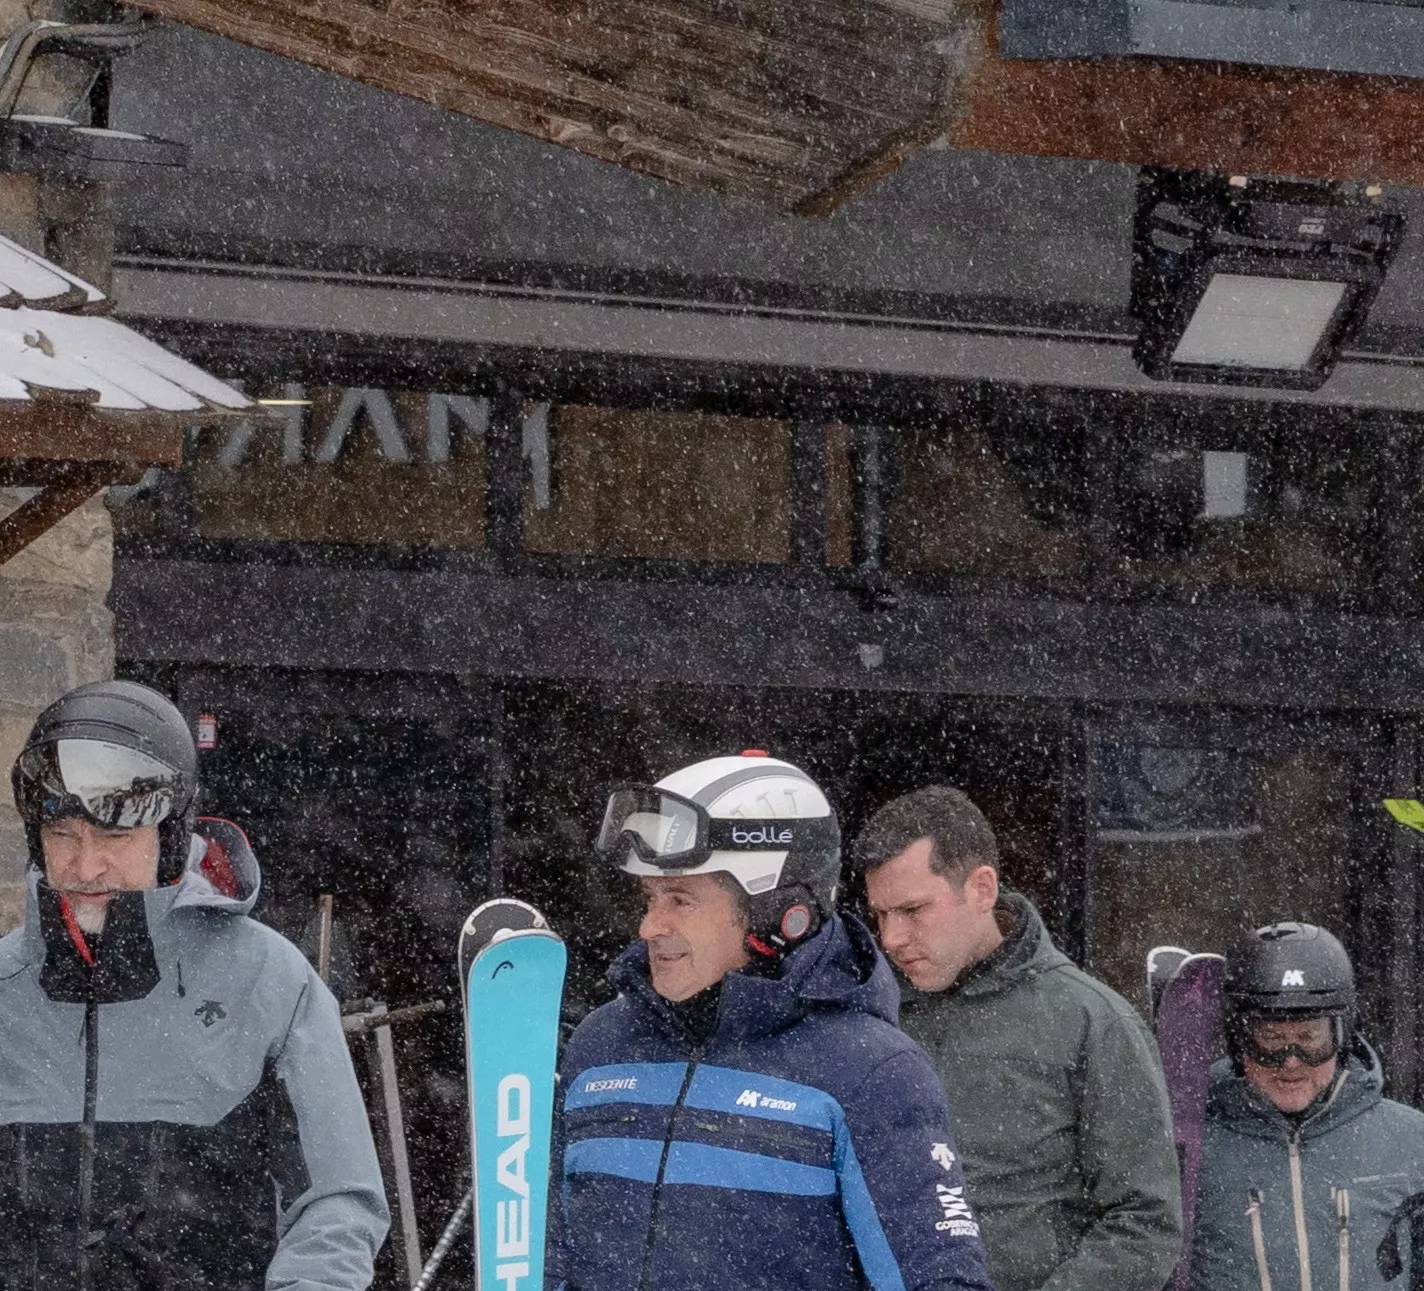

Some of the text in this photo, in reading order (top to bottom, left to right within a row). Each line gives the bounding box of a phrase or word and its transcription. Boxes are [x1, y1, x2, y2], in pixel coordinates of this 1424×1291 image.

[732, 826, 794, 844] bollé
[584, 1076, 639, 1093] DESCENTE
[759, 1096, 797, 1112] aramon
